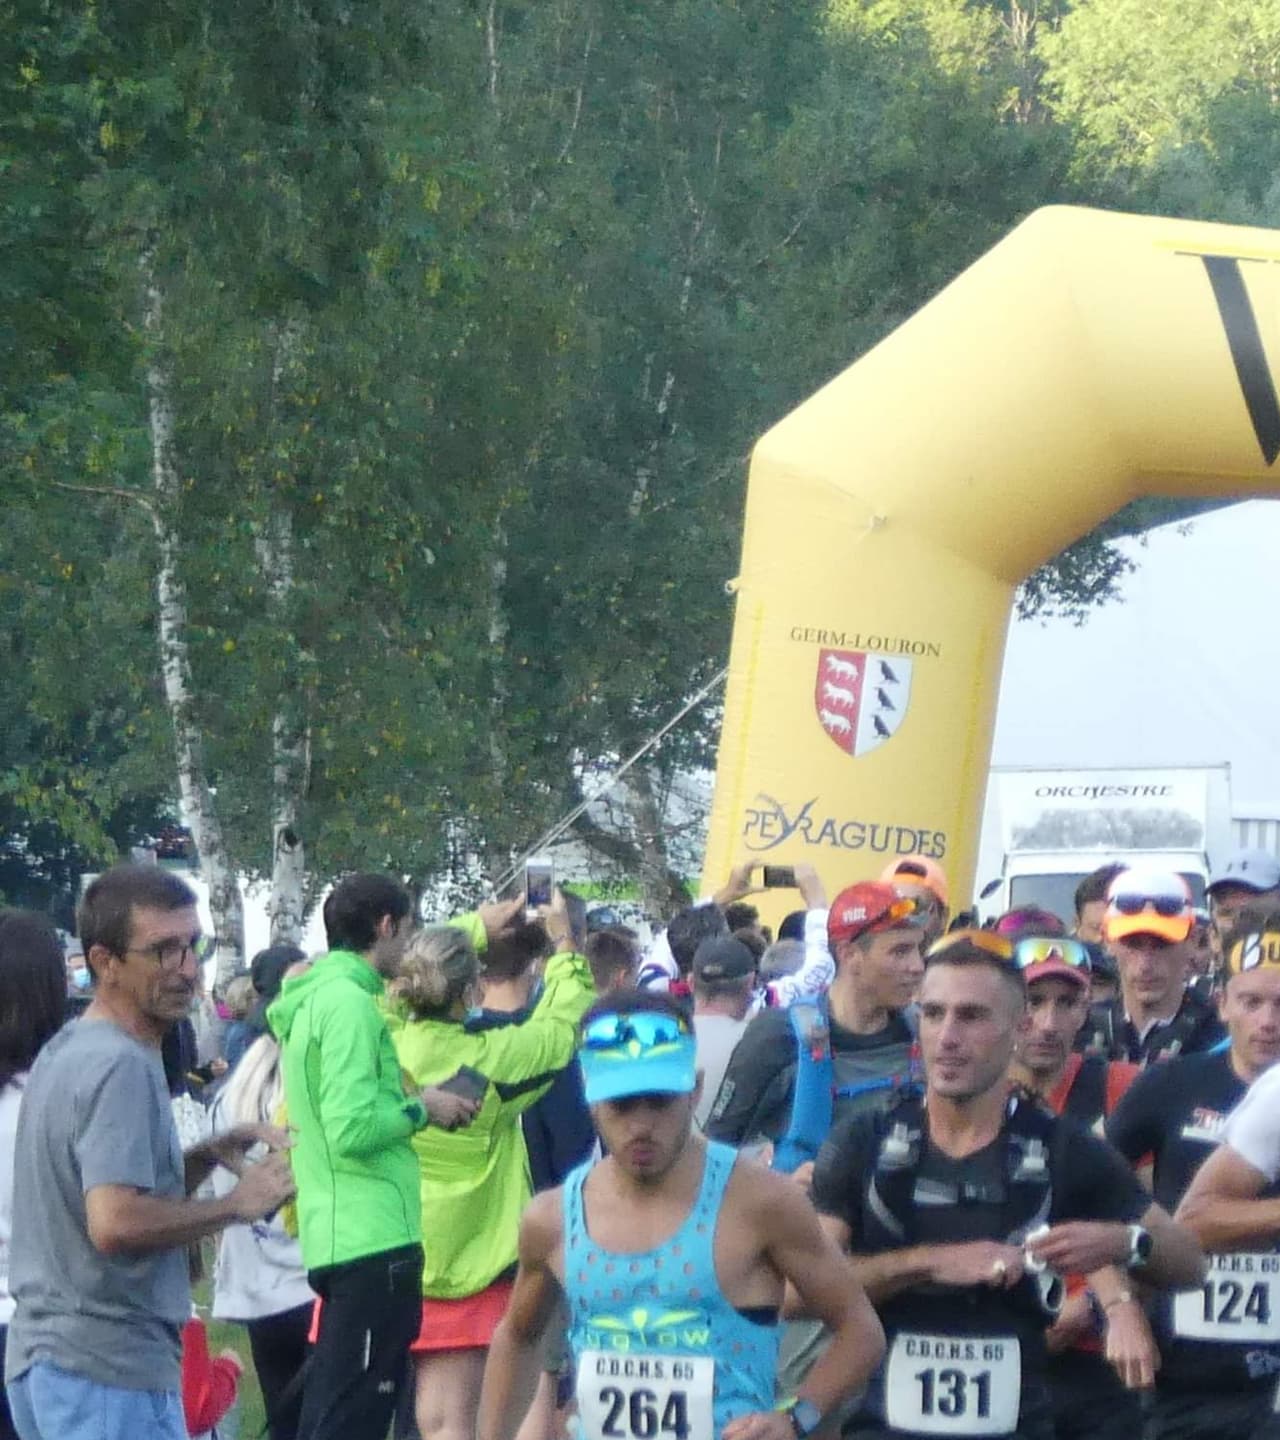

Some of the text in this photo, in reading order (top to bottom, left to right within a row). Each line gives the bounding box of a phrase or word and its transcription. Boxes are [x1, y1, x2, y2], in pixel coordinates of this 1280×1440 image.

[789, 626, 942, 657] GERM-LOURON
[1034, 784, 1175, 800] ORCHESTRE
[743, 792, 947, 859] PEYRAGUDES
[1202, 1279, 1271, 1325] 124
[672, 1360, 695, 1381] 65
[914, 1367, 992, 1420] 131
